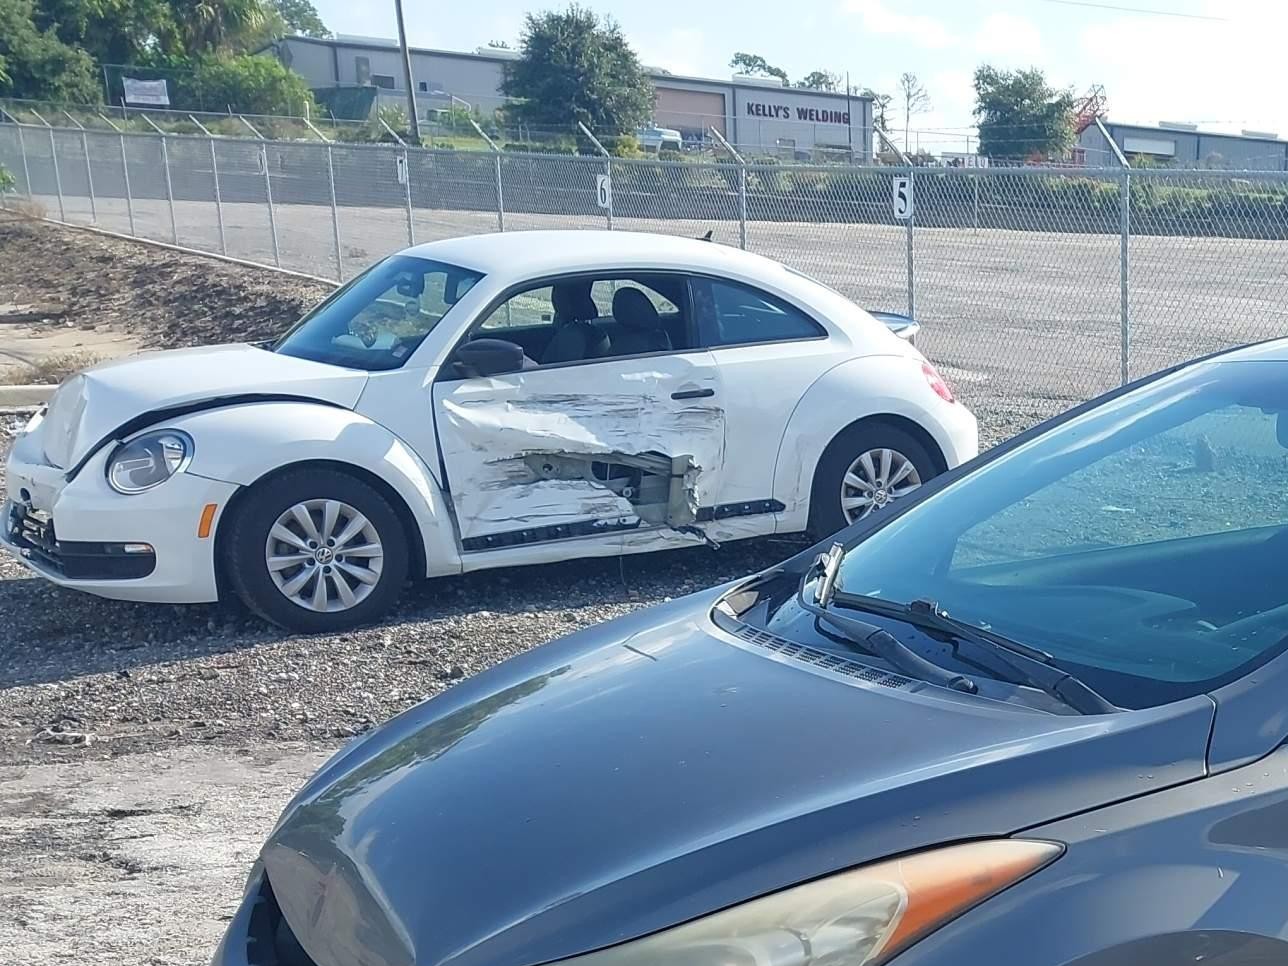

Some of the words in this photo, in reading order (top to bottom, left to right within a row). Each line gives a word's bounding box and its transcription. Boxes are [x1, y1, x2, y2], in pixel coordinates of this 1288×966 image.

[747, 102, 790, 119] KELLY'S
[797, 107, 849, 124] WELDING
[600, 178, 607, 205] 6
[898, 181, 907, 214] 5
